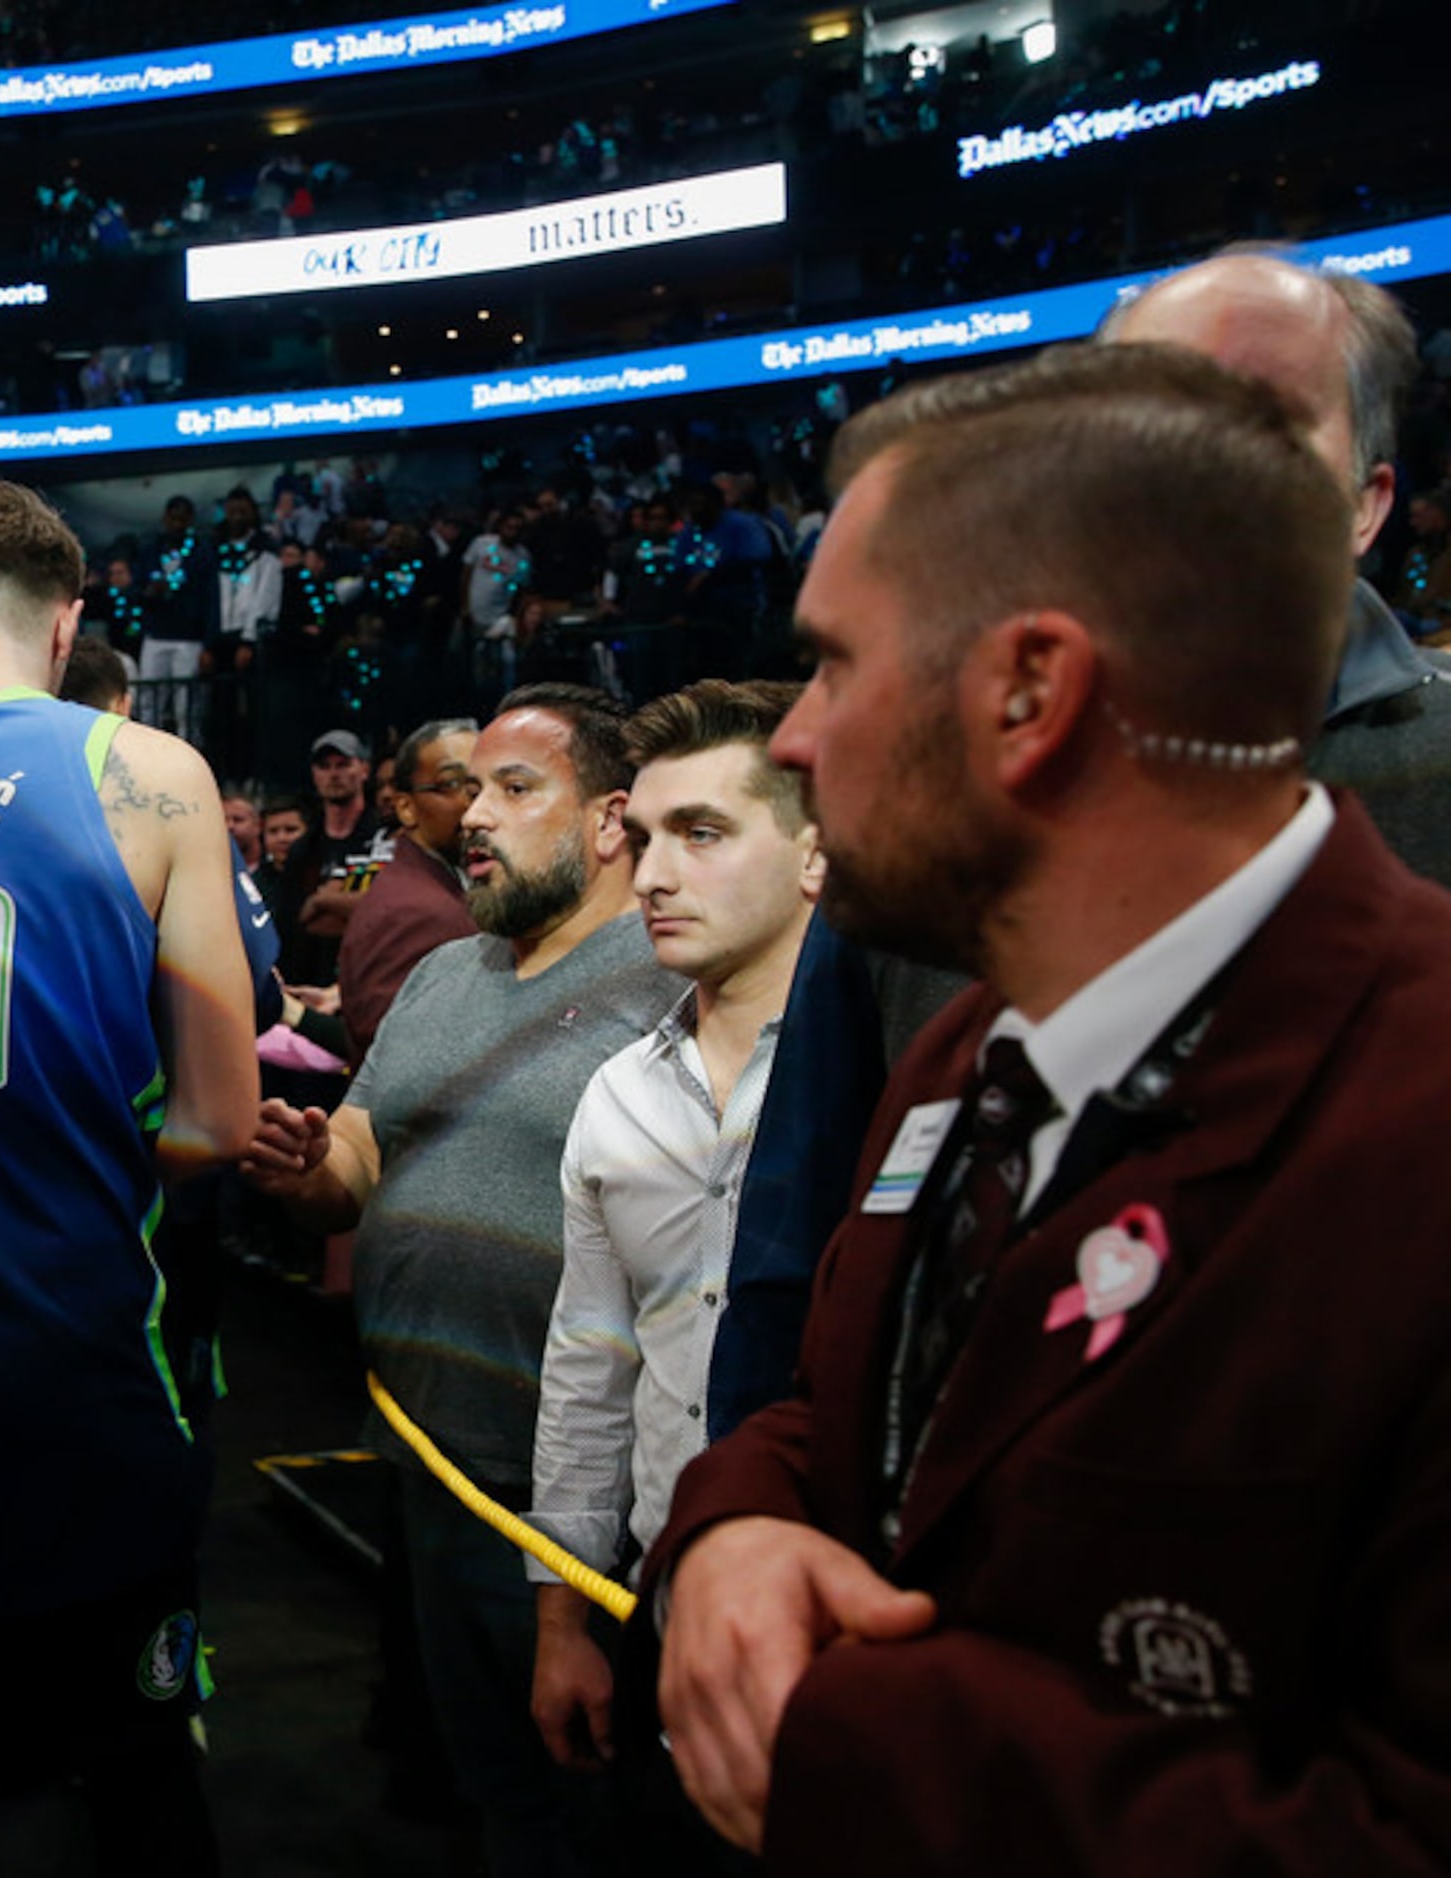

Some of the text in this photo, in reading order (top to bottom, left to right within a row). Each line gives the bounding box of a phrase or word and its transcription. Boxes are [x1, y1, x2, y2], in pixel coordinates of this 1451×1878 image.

[292, 5, 565, 69] The Dallas Morning News
[958, 61, 1321, 177] DallasNews.com/Sports
[529, 199, 699, 252] matters.
[762, 311, 1031, 369] The Dallas Morning News
[176, 396, 404, 435] The Dallas Morning News
